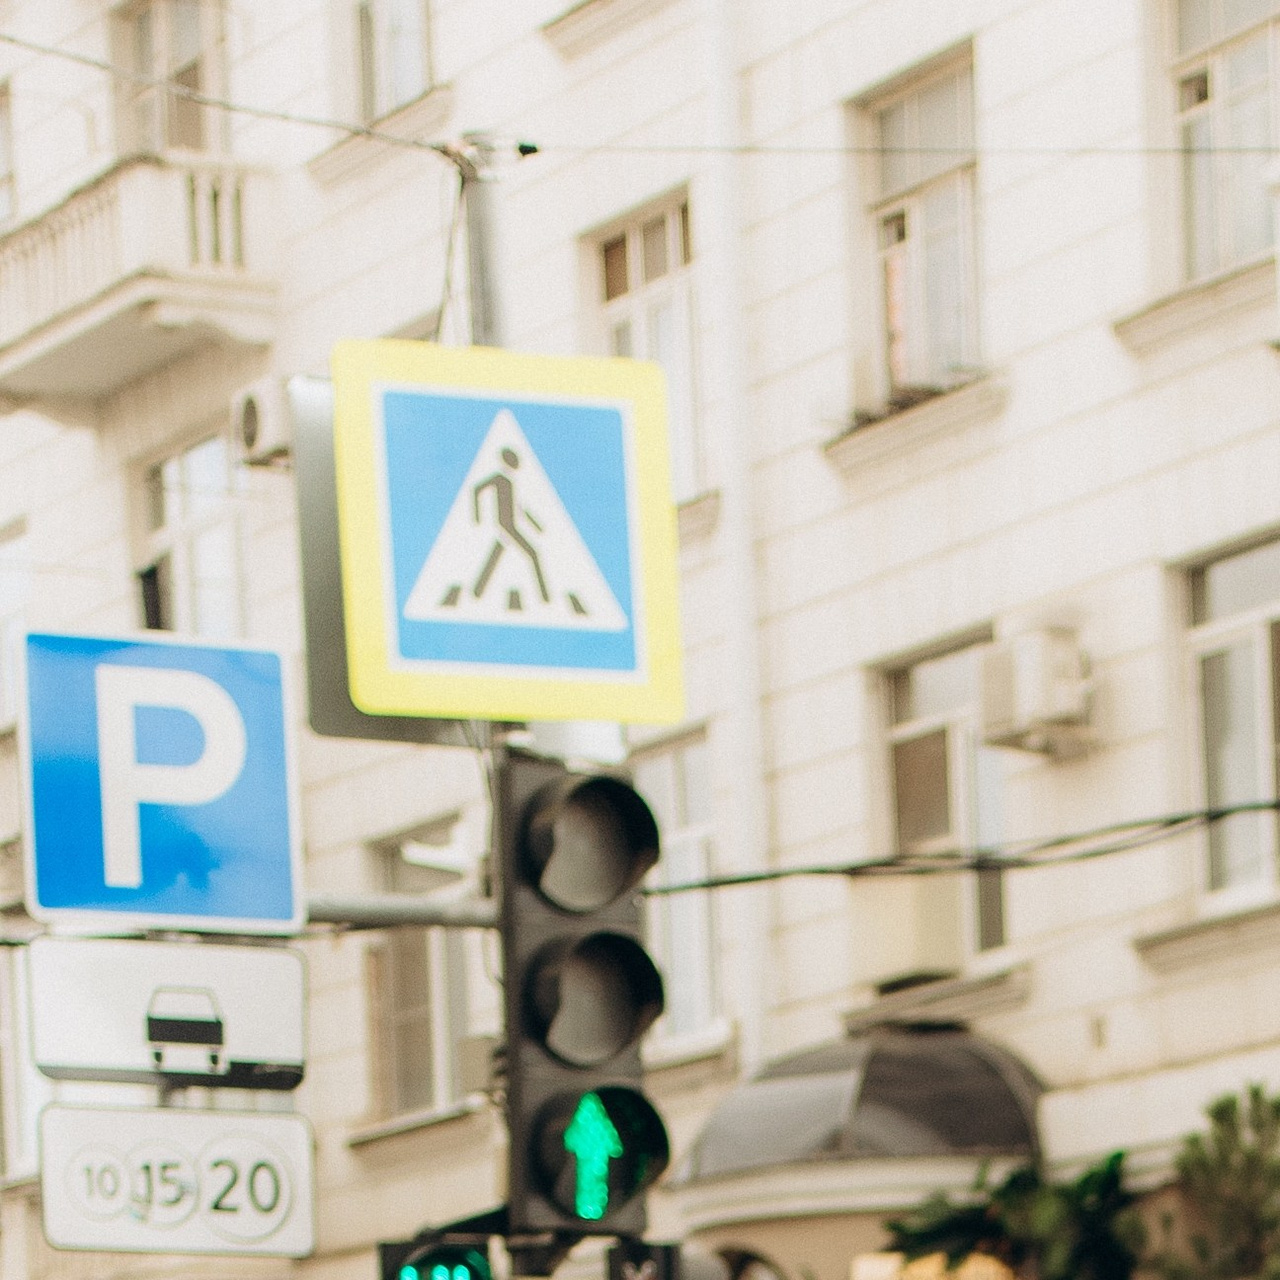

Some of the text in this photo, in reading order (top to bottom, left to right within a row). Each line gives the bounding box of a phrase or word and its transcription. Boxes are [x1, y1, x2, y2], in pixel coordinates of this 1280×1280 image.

[95, 663, 247, 889] P
[83, 1159, 280, 1213] 10 15 20
